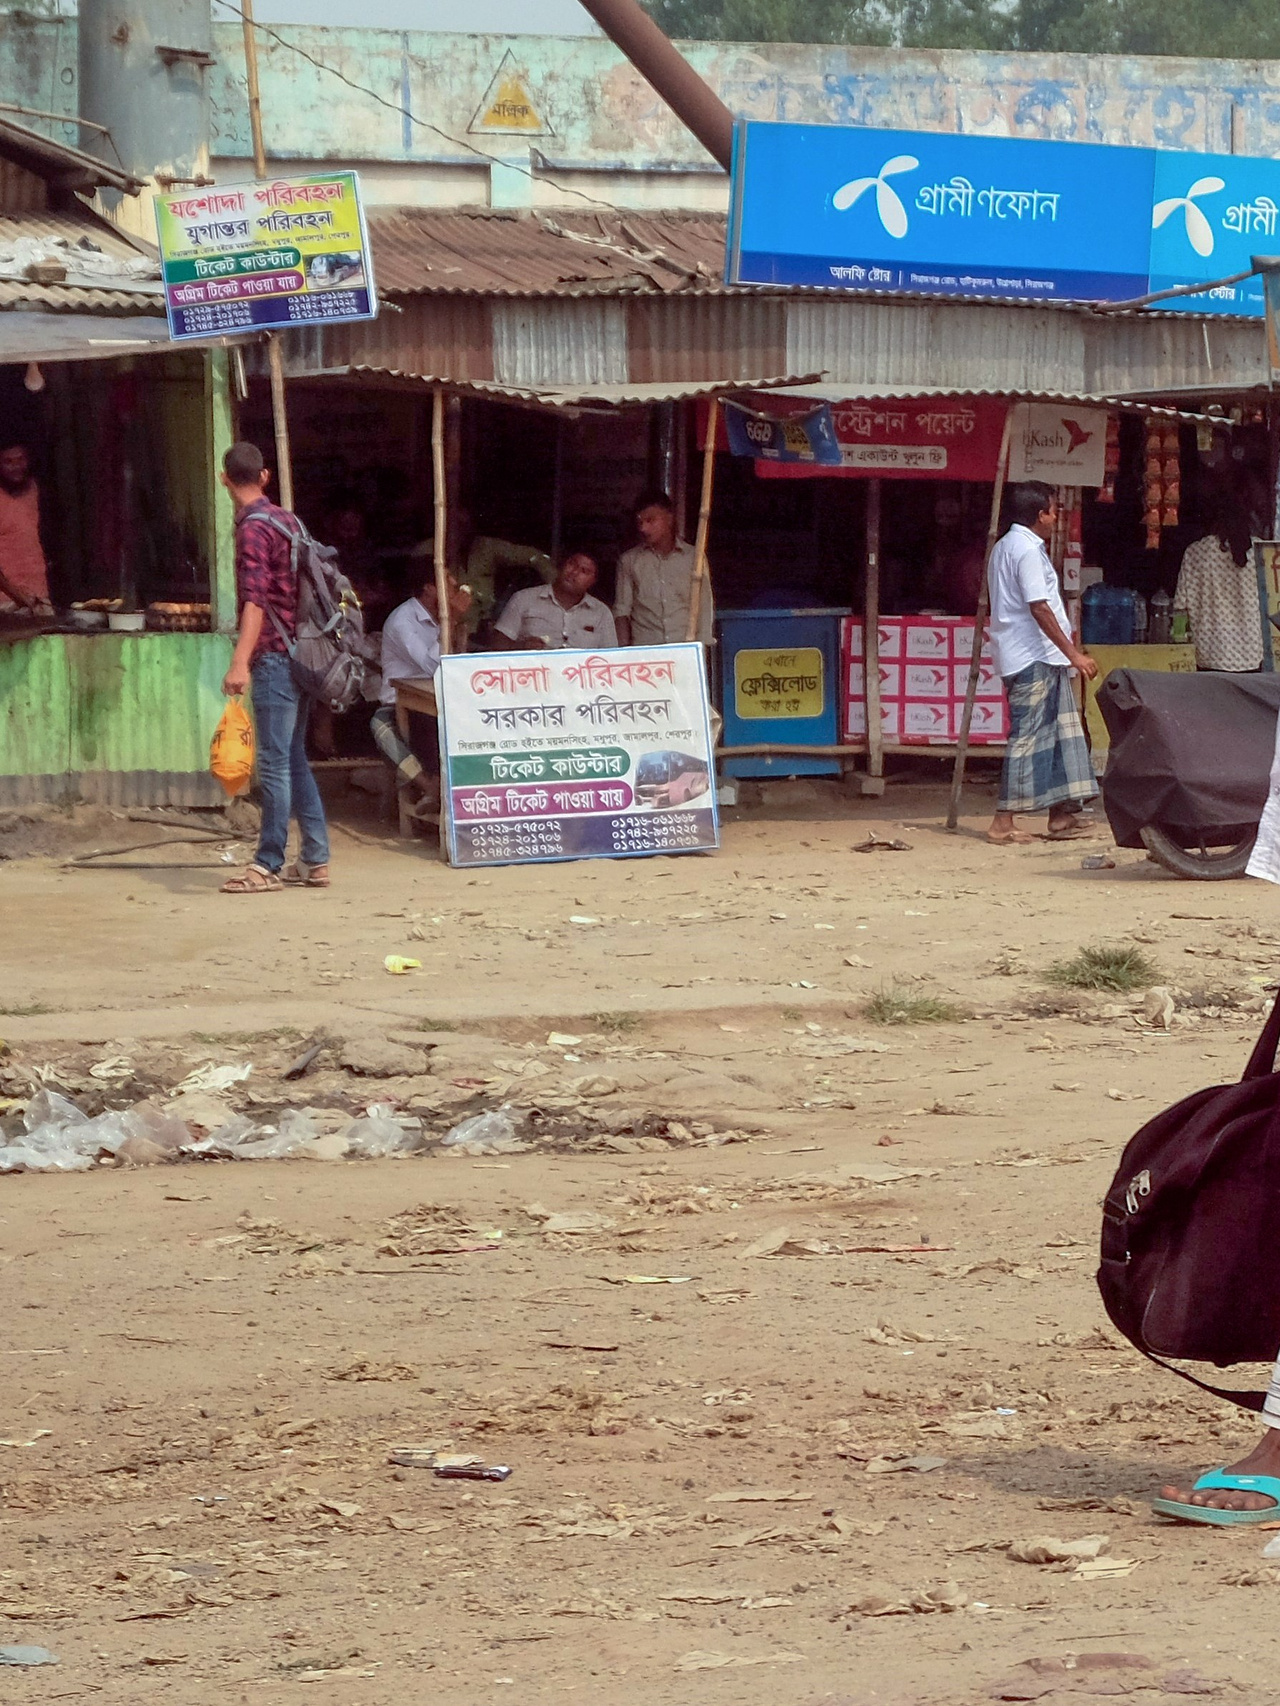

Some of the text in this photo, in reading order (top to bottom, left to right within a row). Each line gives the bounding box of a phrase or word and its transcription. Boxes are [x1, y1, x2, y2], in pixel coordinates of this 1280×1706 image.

[167, 181, 345, 218] যশোদা পরিবহন
[915, 177, 1060, 222] গ্রামীণফোন
[185, 209, 333, 245] যুগান্তর পরিবহন
[194, 250, 295, 277] টিকেট কাউন্টার
[174, 274, 297, 304] অগ্রিম টিকেট পাওয়া যায়
[829, 405, 977, 436] স্ট্রেশন পয়েন্ট
[856, 447, 899, 464] একাউন্ট
[470, 656, 675, 695] সোলা পরিবহন
[741, 672, 818, 697] ফ্লেক্সিলোড
[478, 695, 671, 730] সরকার পরিবহন
[522, 736, 543, 748] হইতে
[490, 751, 622, 781] টিকেট কাউন্টার
[461, 787, 624, 815] অগ্রিম টিকেট পাওয়া যায়
[471, 820, 562, 835] ০১৭২৯-৫৭৫০৭২
[611, 813, 697, 828] ০১৭১৬-০৬১৬৬৮
[612, 824, 698, 840] ০১৭৪২-৯৩৭২২৫
[472, 832, 562, 847] ০১৭২৪-২০১৭০৬
[473, 844, 563, 859] ০১৭৪৫-৩২৪৭৯৬
[613, 836, 699, 851] ০১৭১৬-১৪০৭৩৯
